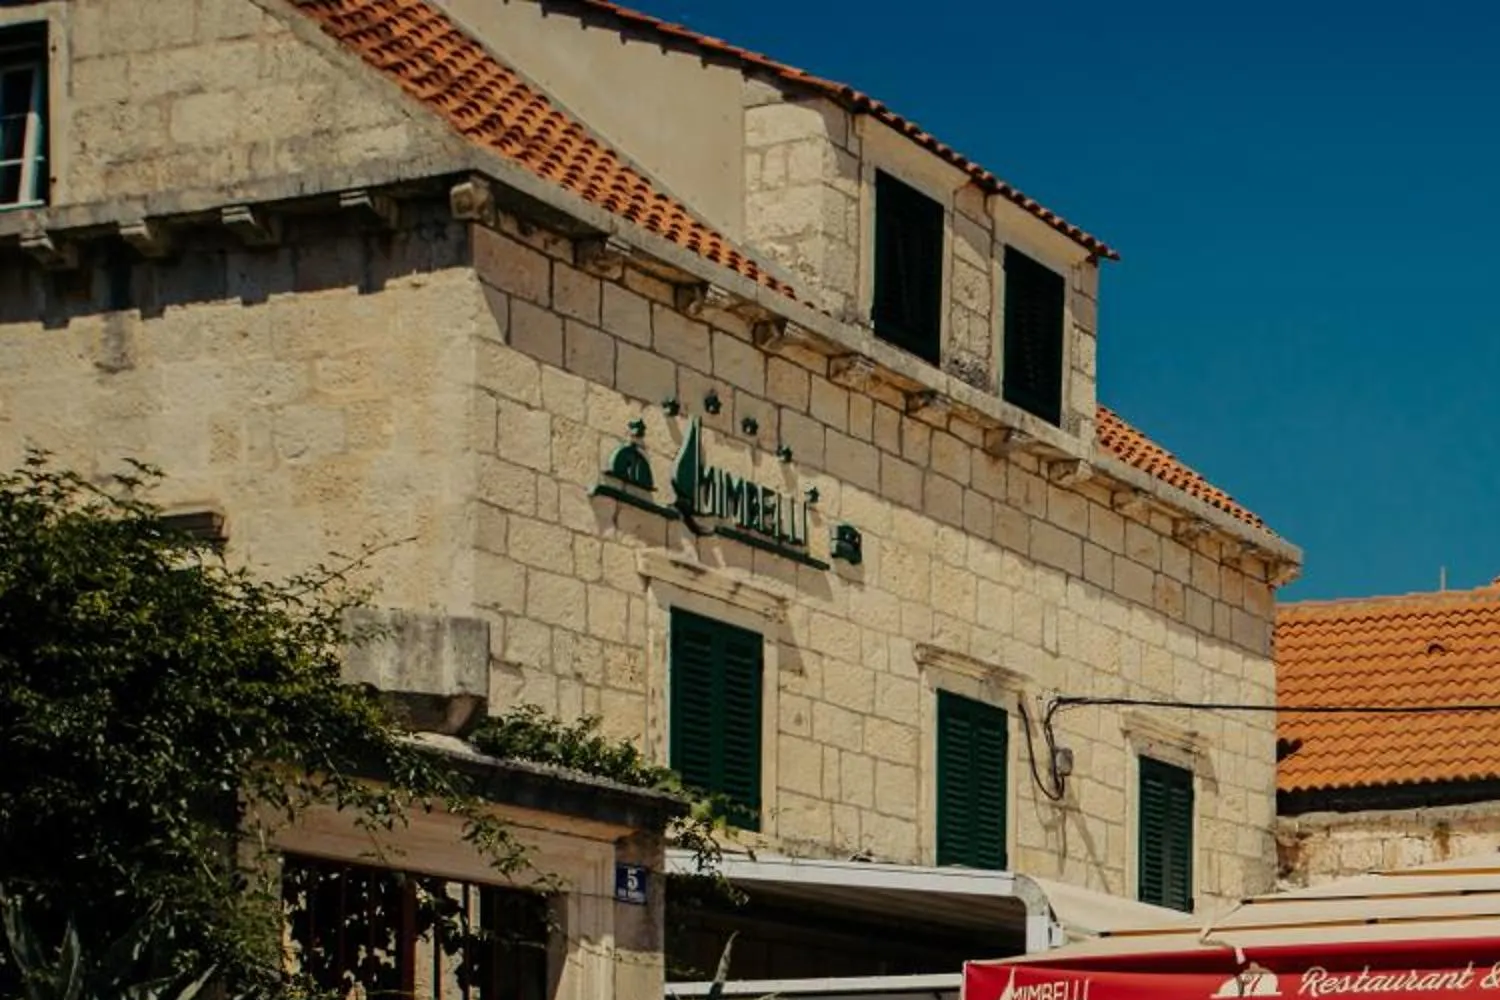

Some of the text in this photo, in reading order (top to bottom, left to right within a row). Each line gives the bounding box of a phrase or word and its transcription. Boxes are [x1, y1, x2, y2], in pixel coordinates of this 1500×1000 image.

[694, 462, 809, 547] MIMBELLI
[626, 867, 639, 891] 5
[1298, 961, 1474, 998] Restaurant
